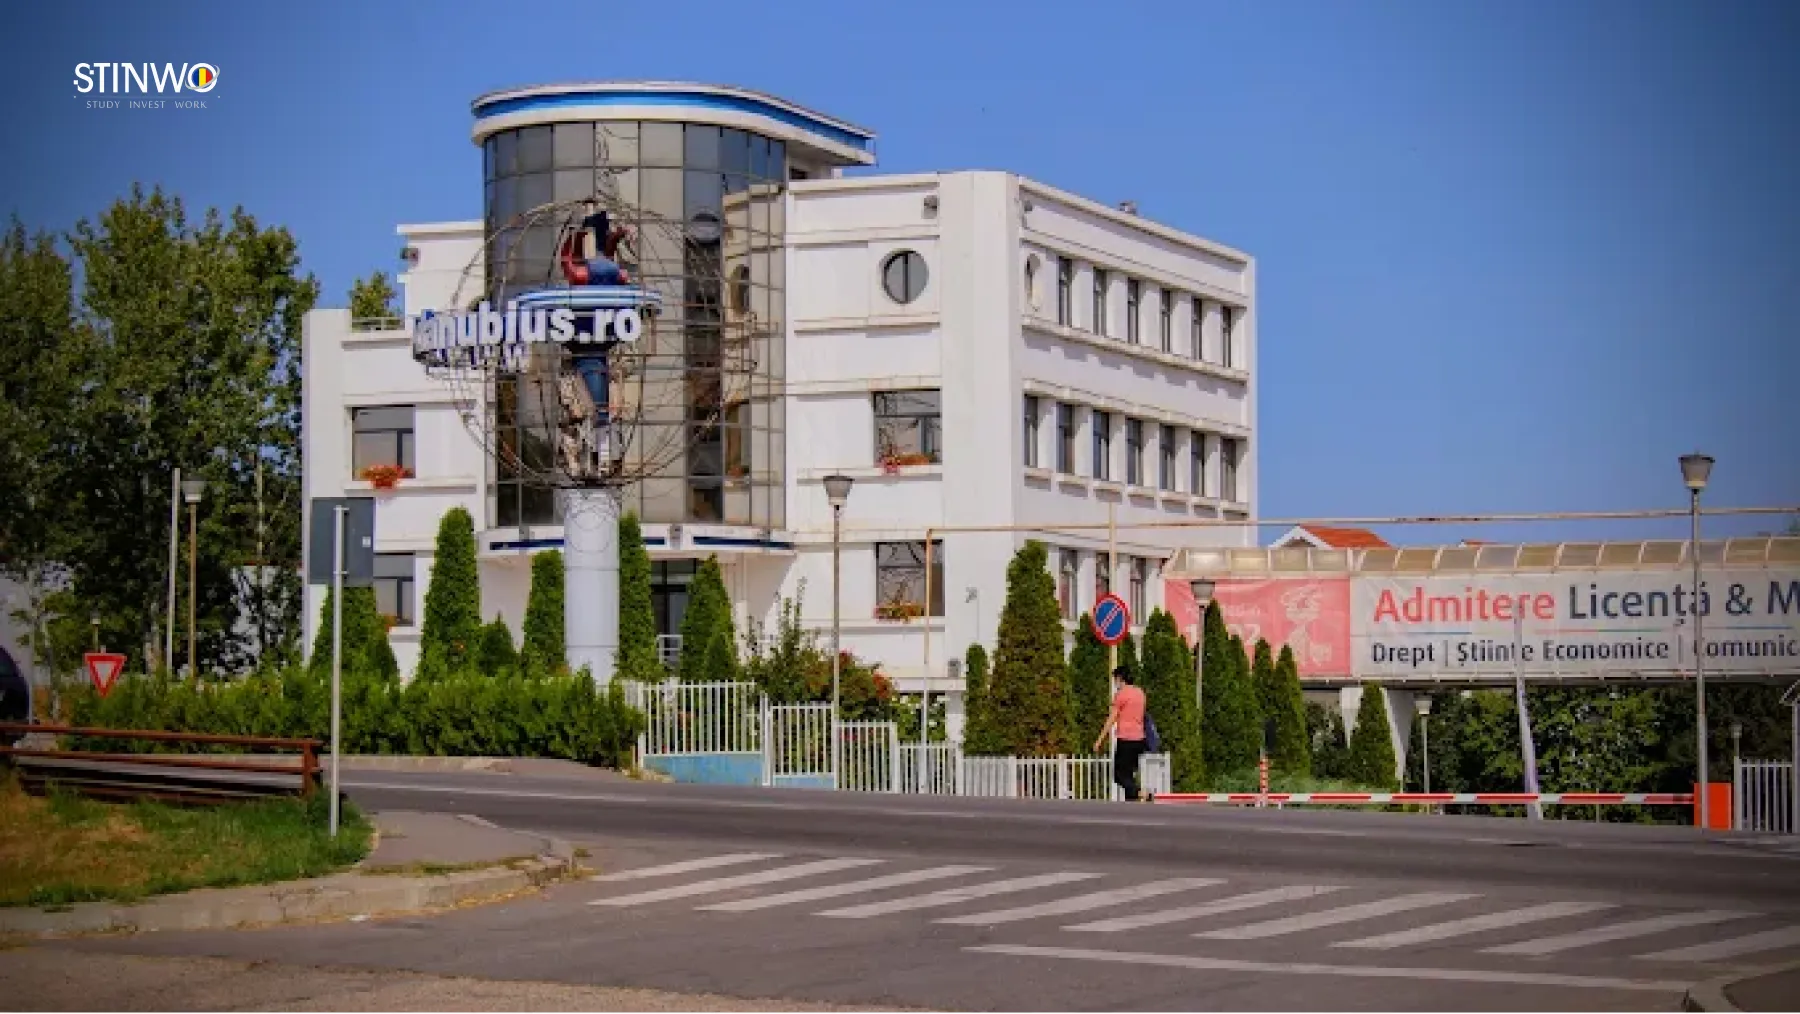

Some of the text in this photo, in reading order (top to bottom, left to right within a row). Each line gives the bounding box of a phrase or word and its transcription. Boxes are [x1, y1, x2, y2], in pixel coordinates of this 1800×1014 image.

[1373, 586, 1555, 622] Admitere
[1725, 583, 1753, 616] &
[1373, 642, 1435, 668] Drept
[1543, 636, 1669, 661] Economice
